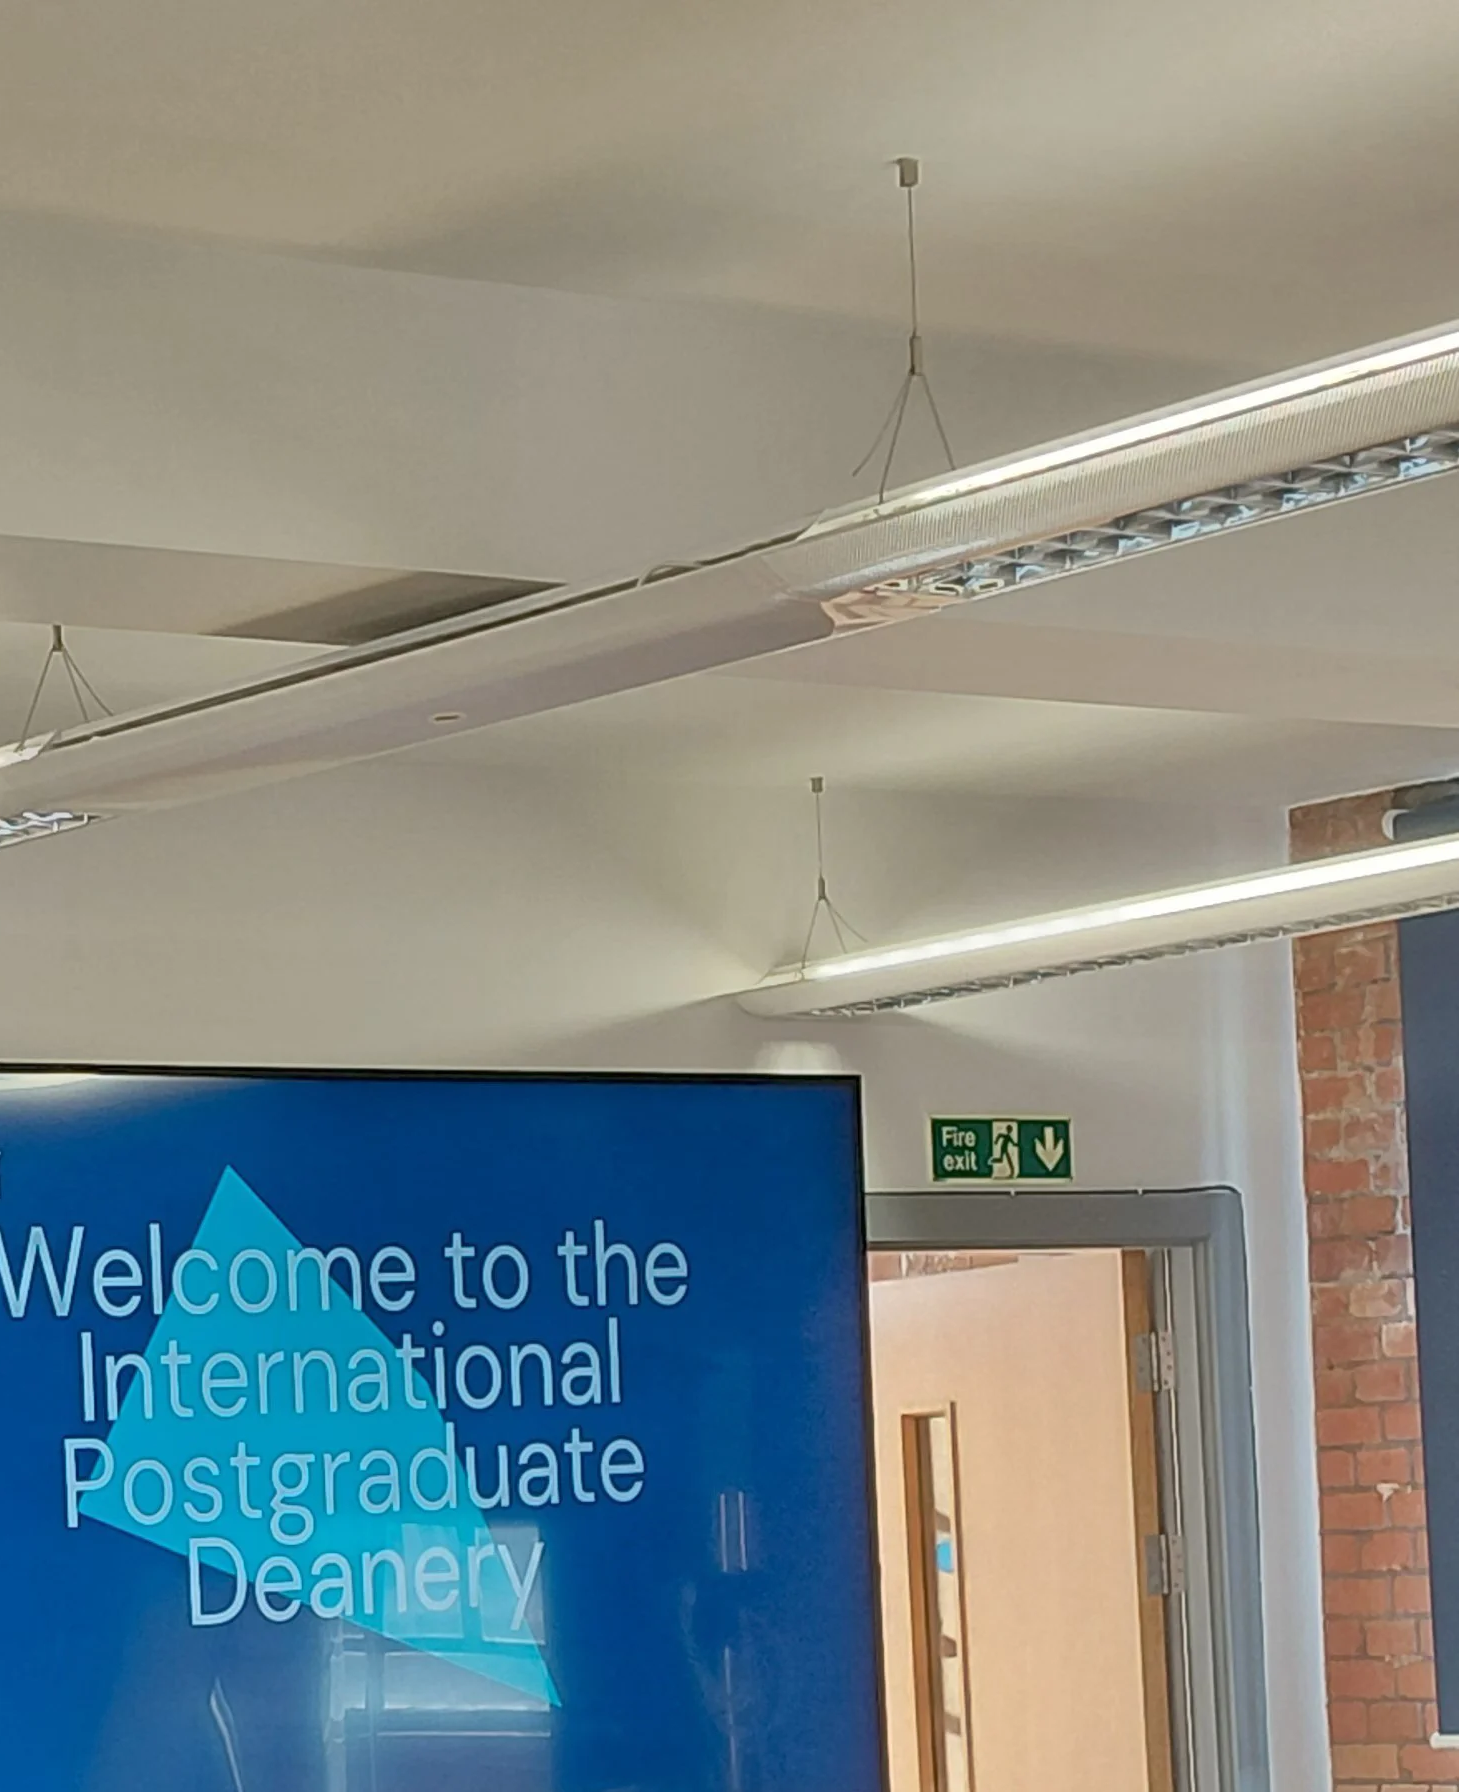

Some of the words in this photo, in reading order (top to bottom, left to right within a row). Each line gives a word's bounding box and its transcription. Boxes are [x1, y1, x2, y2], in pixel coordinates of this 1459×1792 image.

[941, 1126, 976, 1147] Fire
[943, 1151, 977, 1171] exit
[444, 1231, 530, 1311] to
[557, 1219, 689, 1306] the
[79, 1316, 621, 1422] International
[63, 1422, 645, 1546] Postgraduate
[187, 1537, 545, 1631] Deanery
